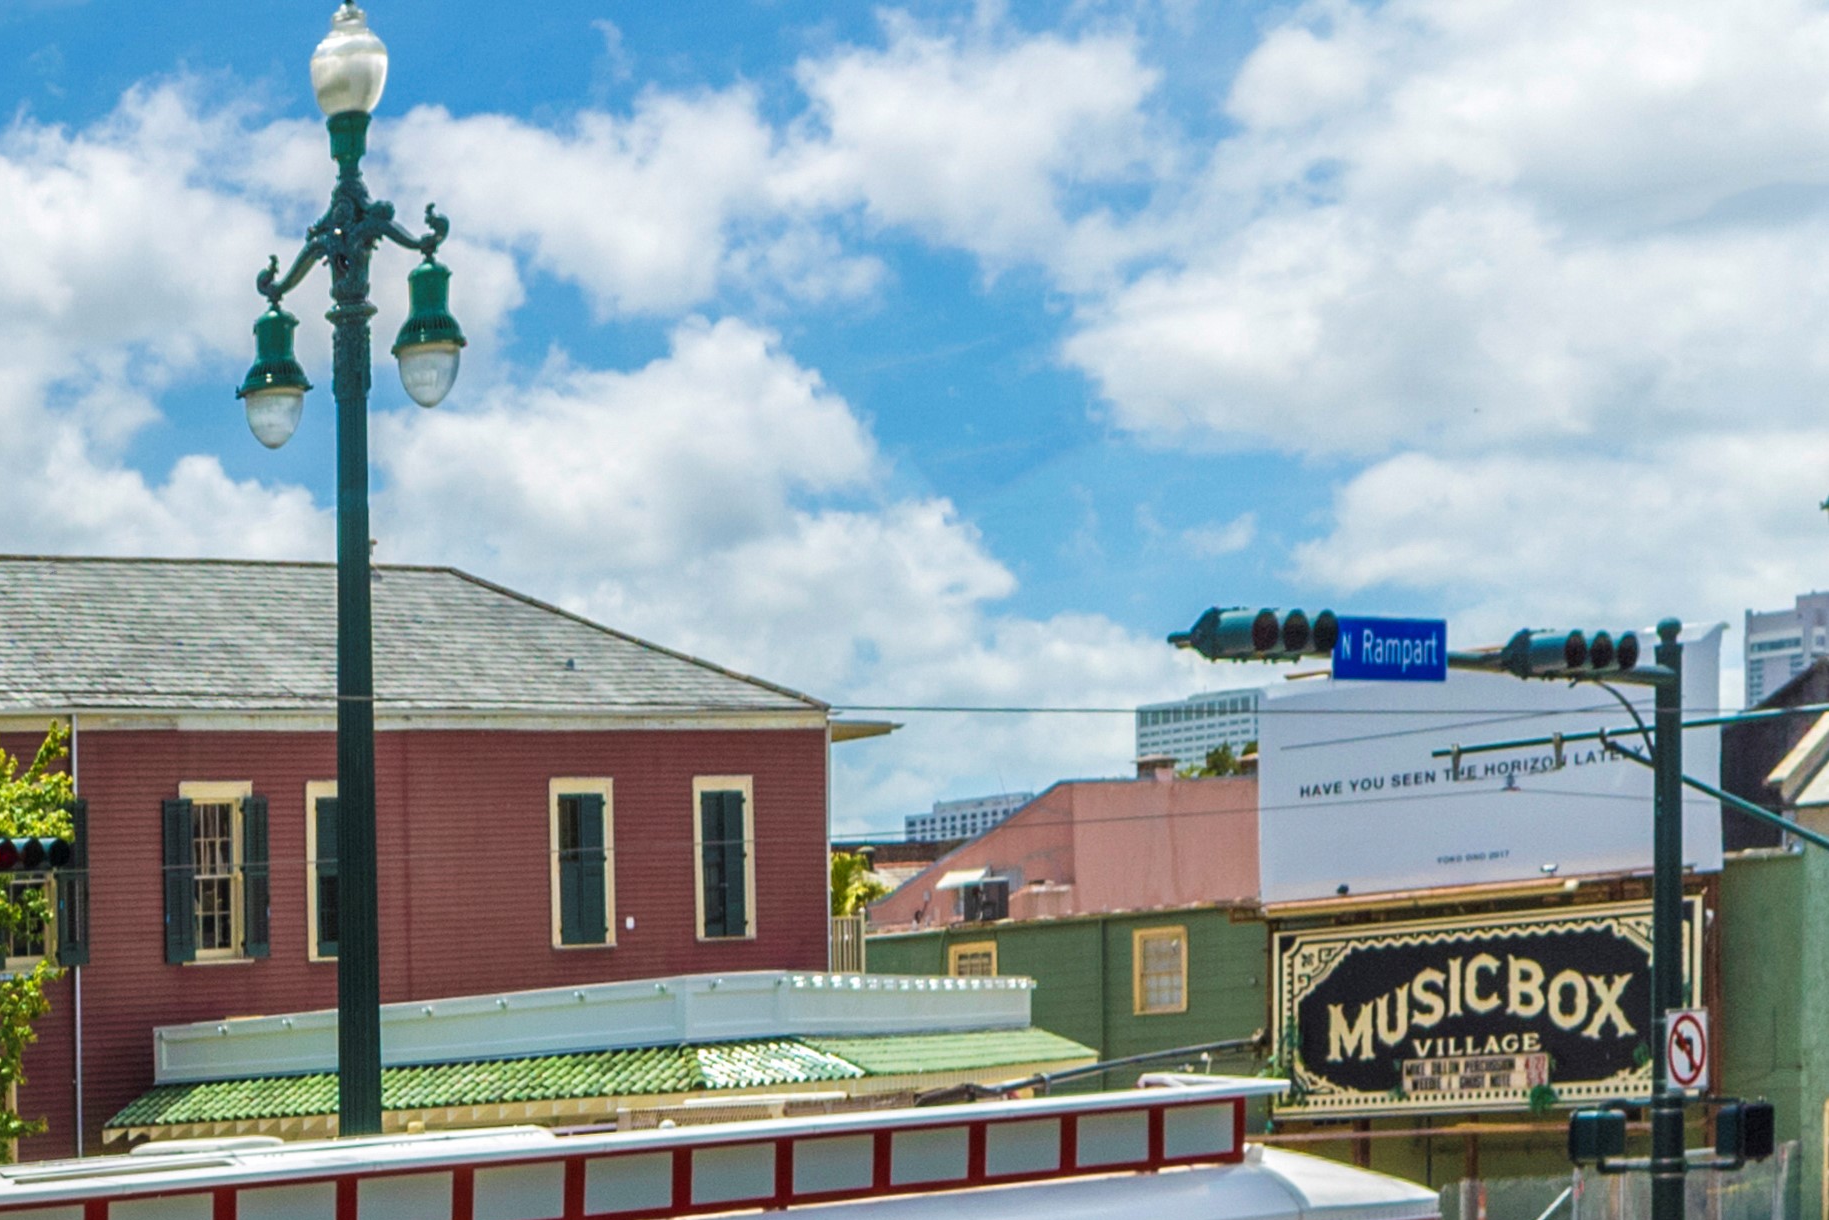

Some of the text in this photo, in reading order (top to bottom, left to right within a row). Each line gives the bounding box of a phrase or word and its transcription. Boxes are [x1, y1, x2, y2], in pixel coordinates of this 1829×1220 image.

[1341, 629, 1438, 673] N Rampart
[1300, 781, 1343, 798] HAVE
[1350, 776, 1384, 792] YOU
[1391, 770, 1437, 788] SEEN
[1574, 745, 1645, 766] LATEY
[1413, 1031, 1542, 1058] VILLAGE
